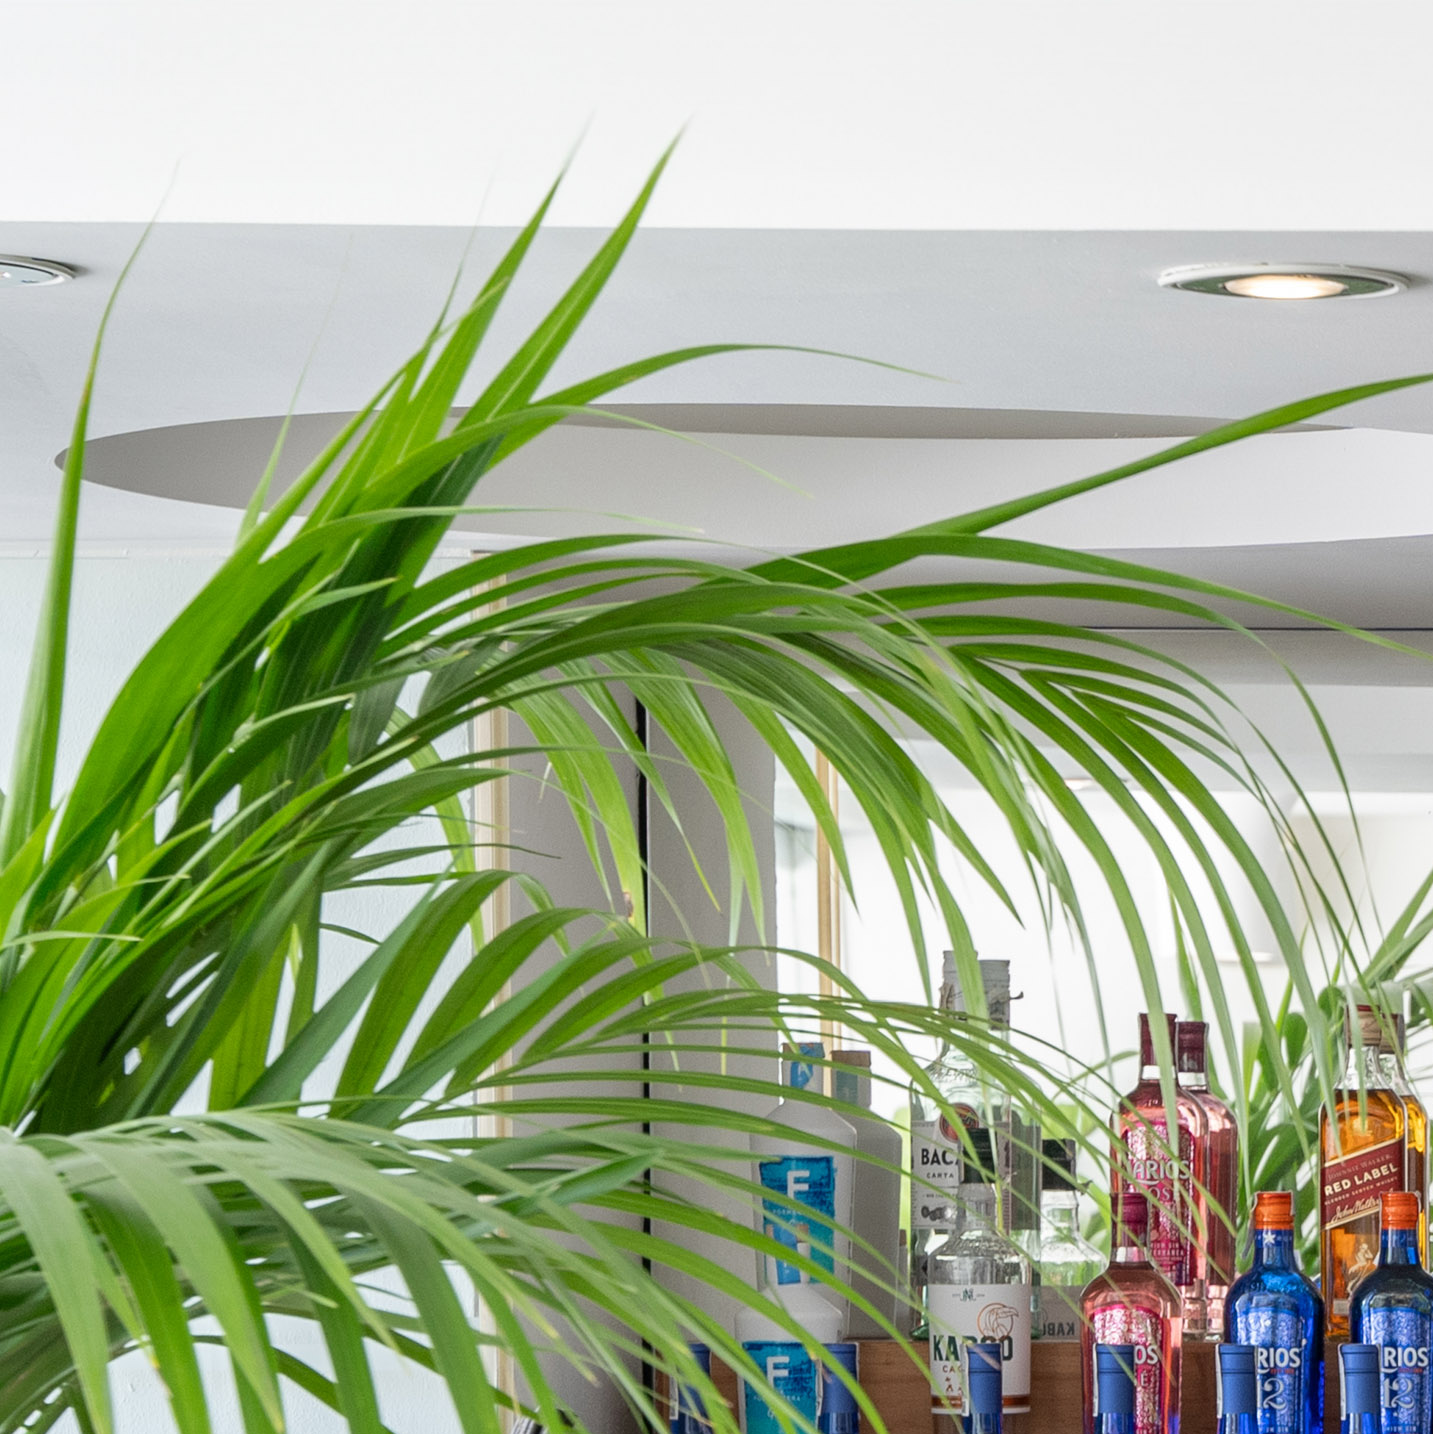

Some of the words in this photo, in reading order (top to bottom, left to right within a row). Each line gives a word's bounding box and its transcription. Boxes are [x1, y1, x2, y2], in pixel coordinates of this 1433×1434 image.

[1324, 1178, 1352, 1197] RED
[1354, 1163, 1399, 1185] LABEL
[1257, 1347, 1301, 1369] RIOS
[1383, 1346, 1429, 1368] RIOS
[1383, 1378, 1416, 1409] 12
